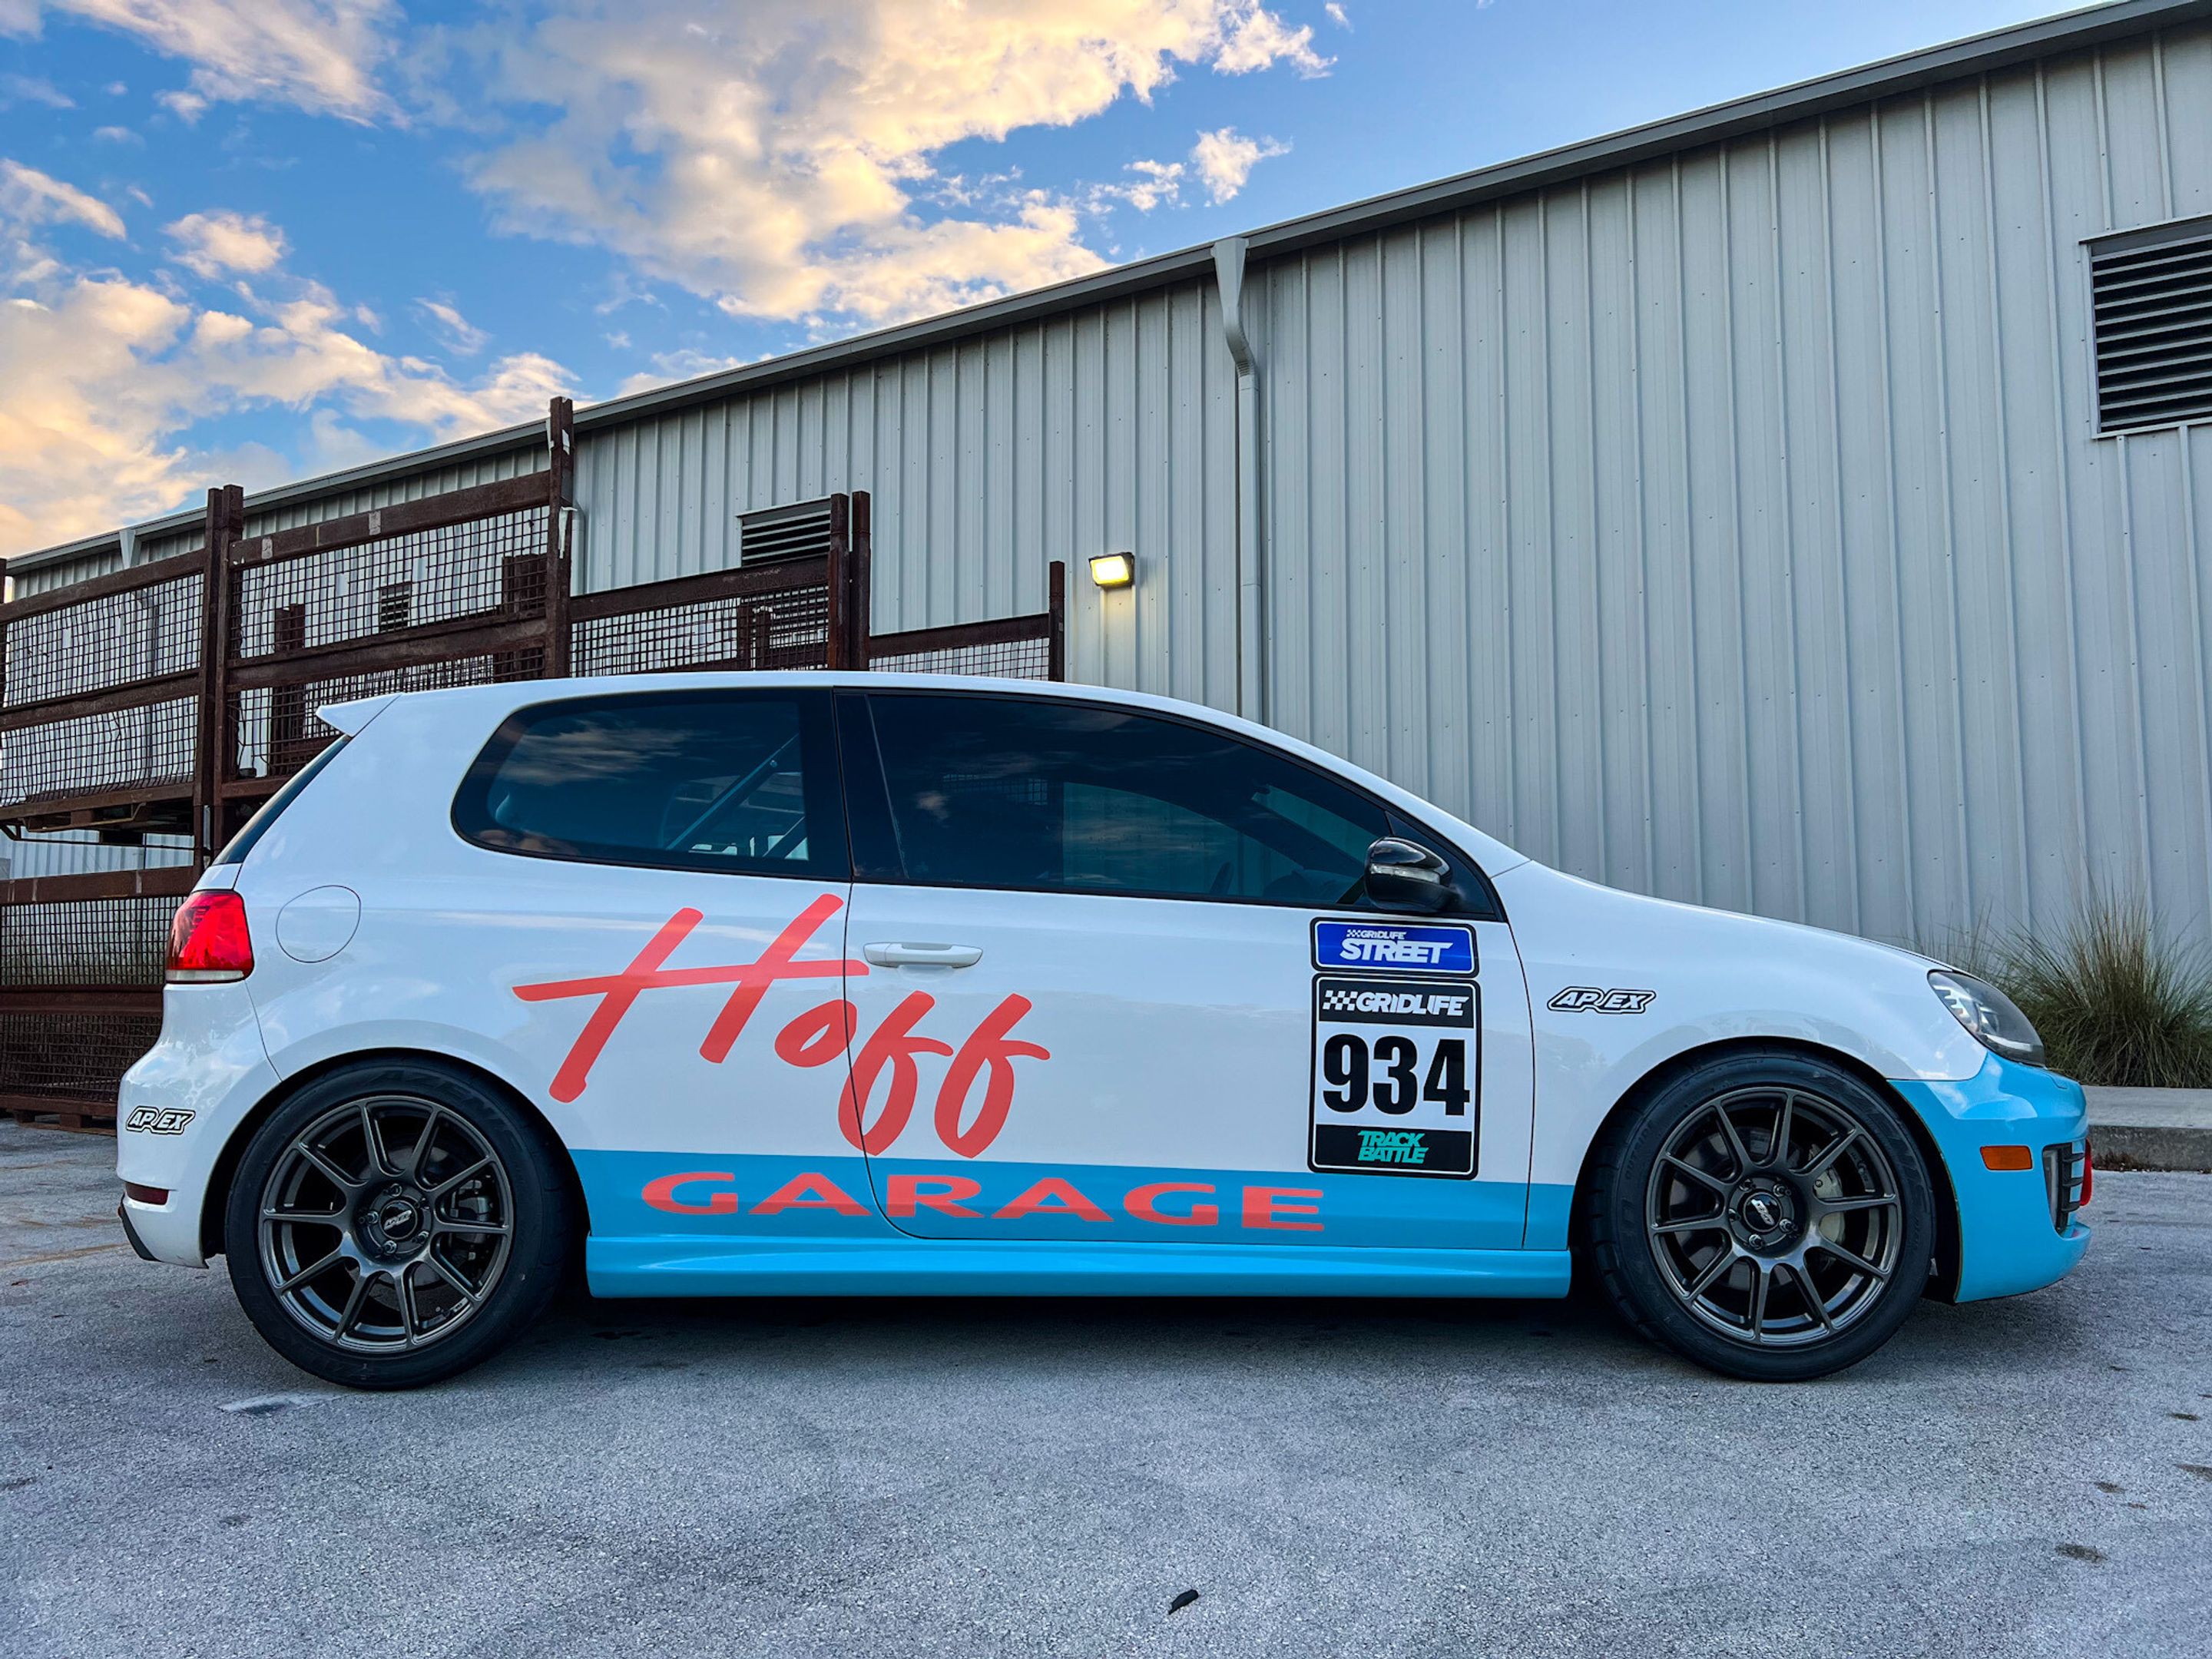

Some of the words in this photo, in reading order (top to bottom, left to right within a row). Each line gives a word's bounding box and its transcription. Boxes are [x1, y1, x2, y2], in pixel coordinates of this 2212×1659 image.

[1359, 930, 1406, 940] GRIDLIFE
[1339, 938, 1453, 964] STREET
[1355, 991, 1469, 1017] GRIDLIFE
[1553, 989, 1651, 1011] APEX
[512, 892, 1051, 1159] Hoff
[1323, 1034, 1470, 1117] 934
[127, 1109, 191, 1131] APEX
[1357, 1130, 1426, 1147] TRACK
[1356, 1146, 1429, 1164] BATTLE
[641, 1171, 1325, 1231] GARAGE
